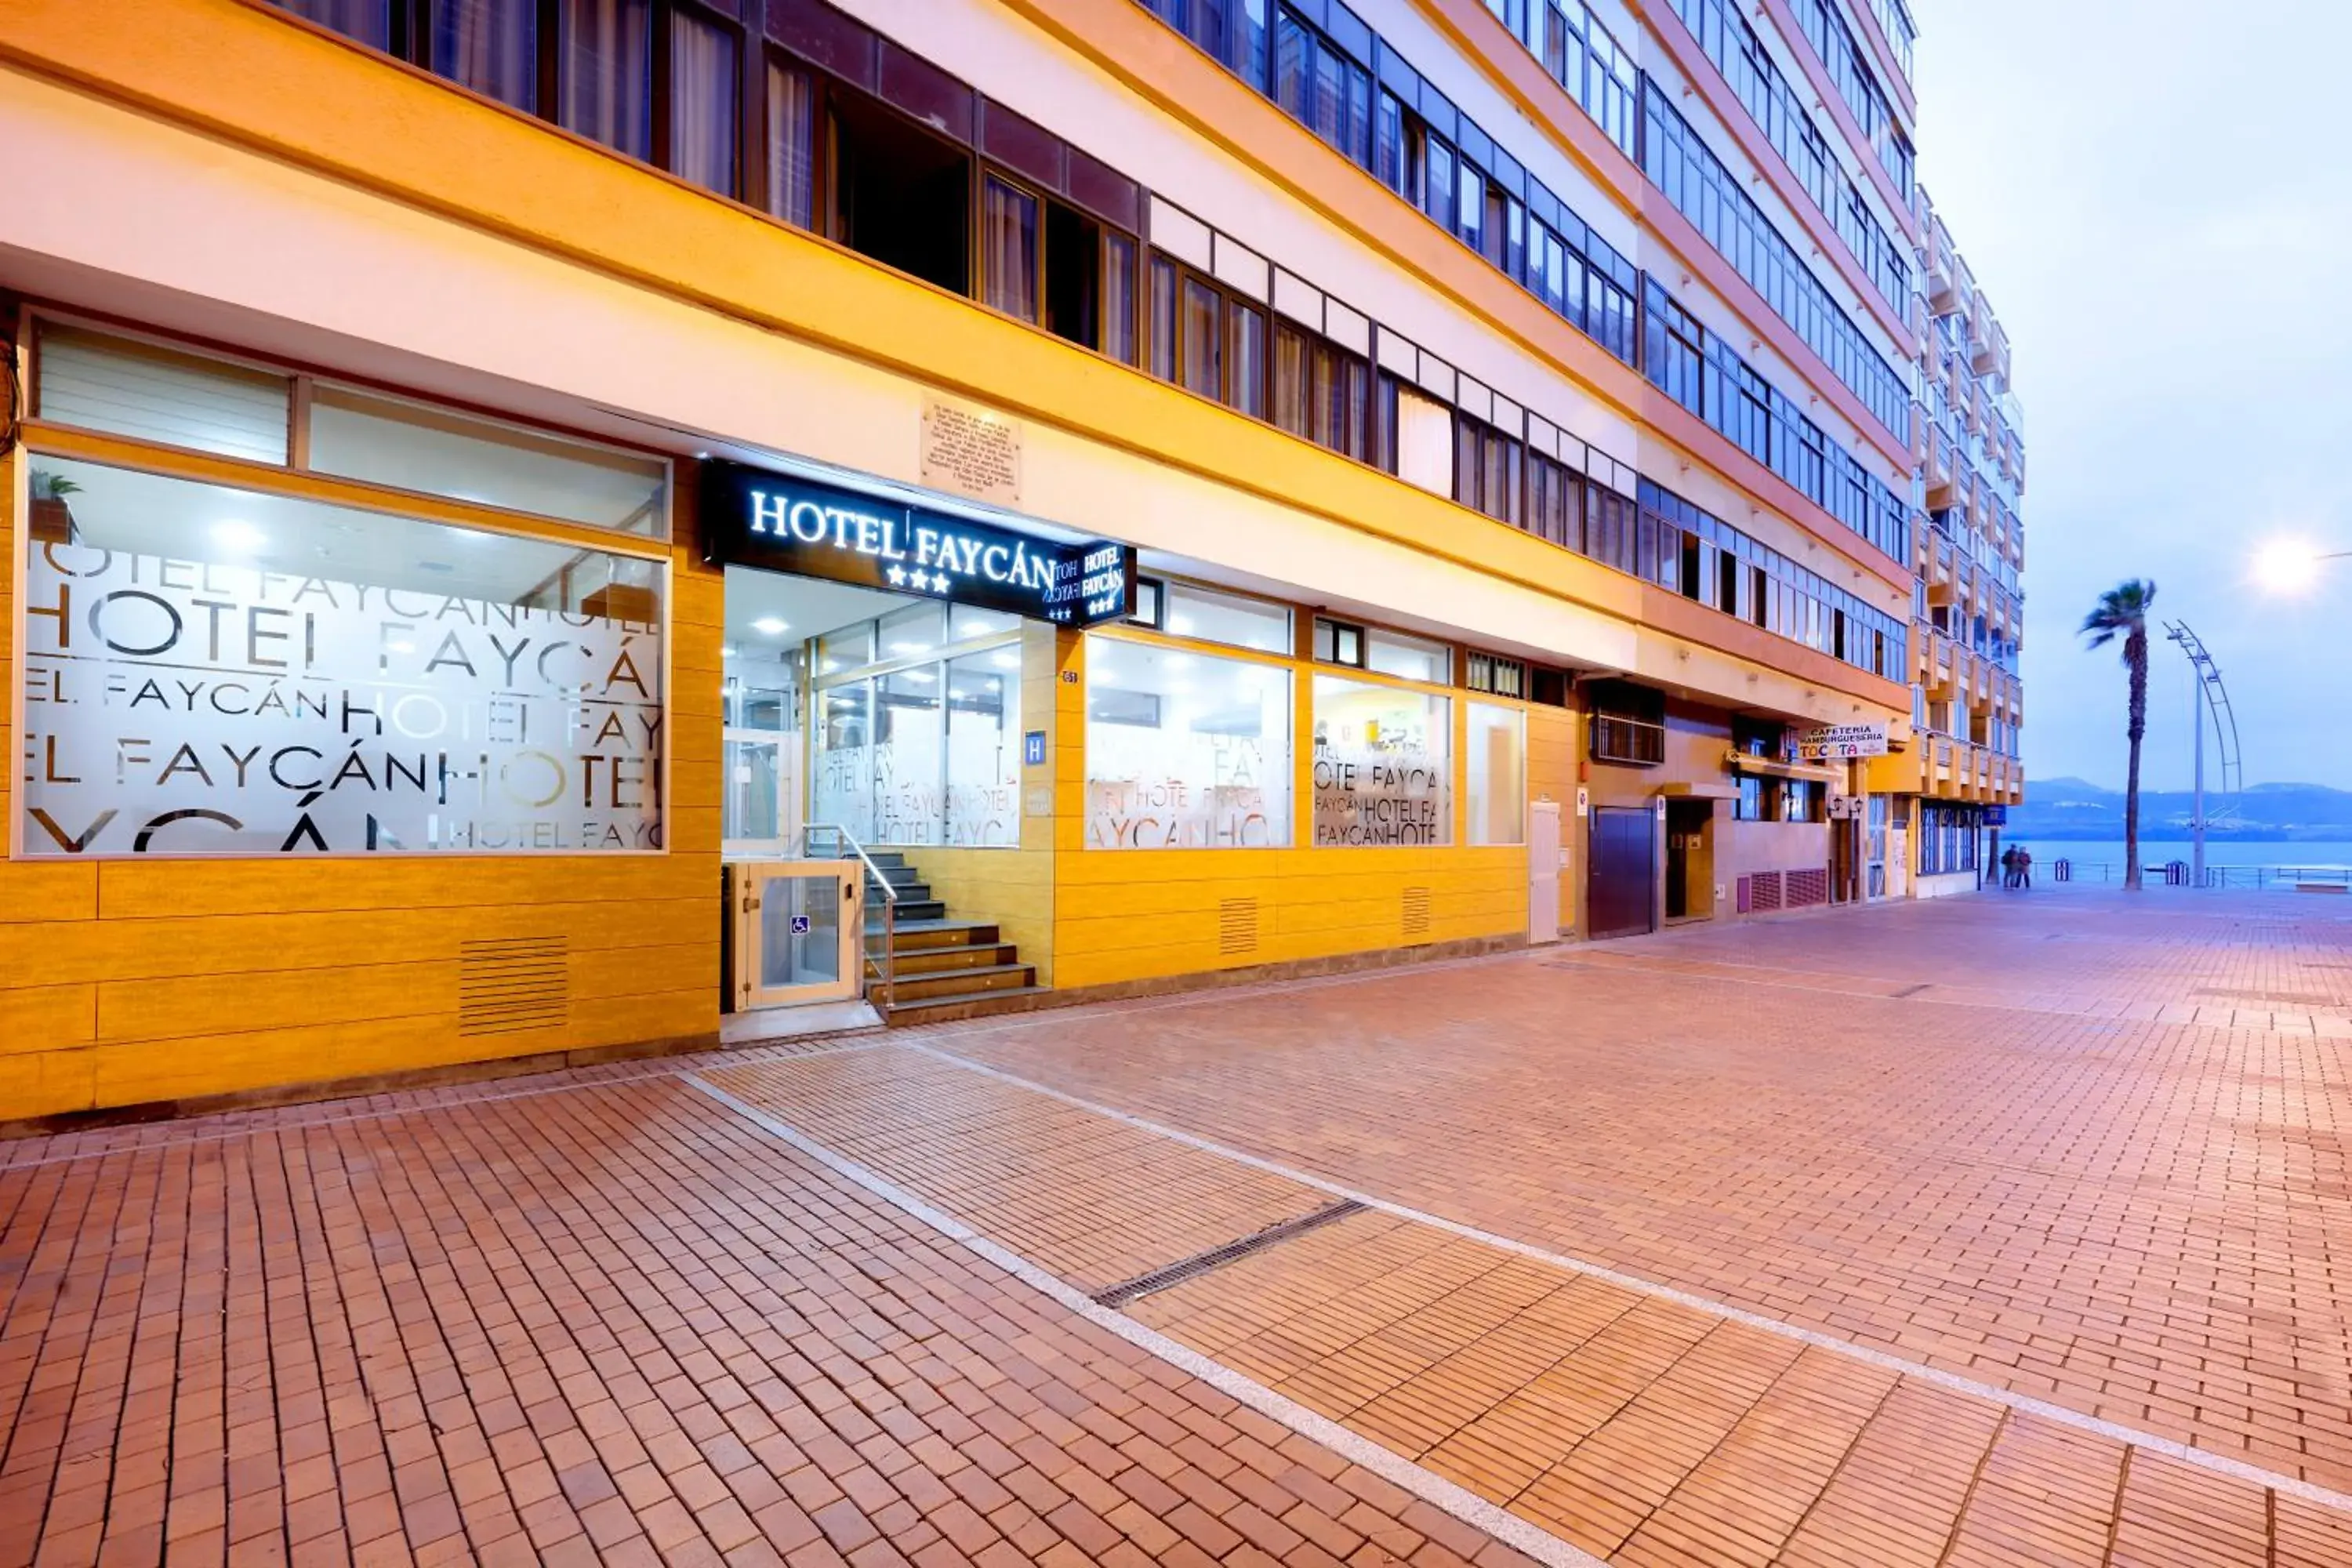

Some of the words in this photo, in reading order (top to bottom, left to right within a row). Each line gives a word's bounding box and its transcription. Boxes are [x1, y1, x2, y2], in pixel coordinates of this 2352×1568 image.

[751, 492, 906, 560] HOTEL
[915, 528, 1057, 591] FAYCÁN
[1084, 546, 1120, 573] HOTEL
[1083, 564, 1124, 597] FAYCÁN
[103, 674, 327, 720] FAYCÁN
[1029, 739, 1040, 761] H
[1800, 744, 1857, 757] TOCTA
[118, 739, 426, 793] FAYCÁN
[1364, 797, 1416, 823] HOTEL
